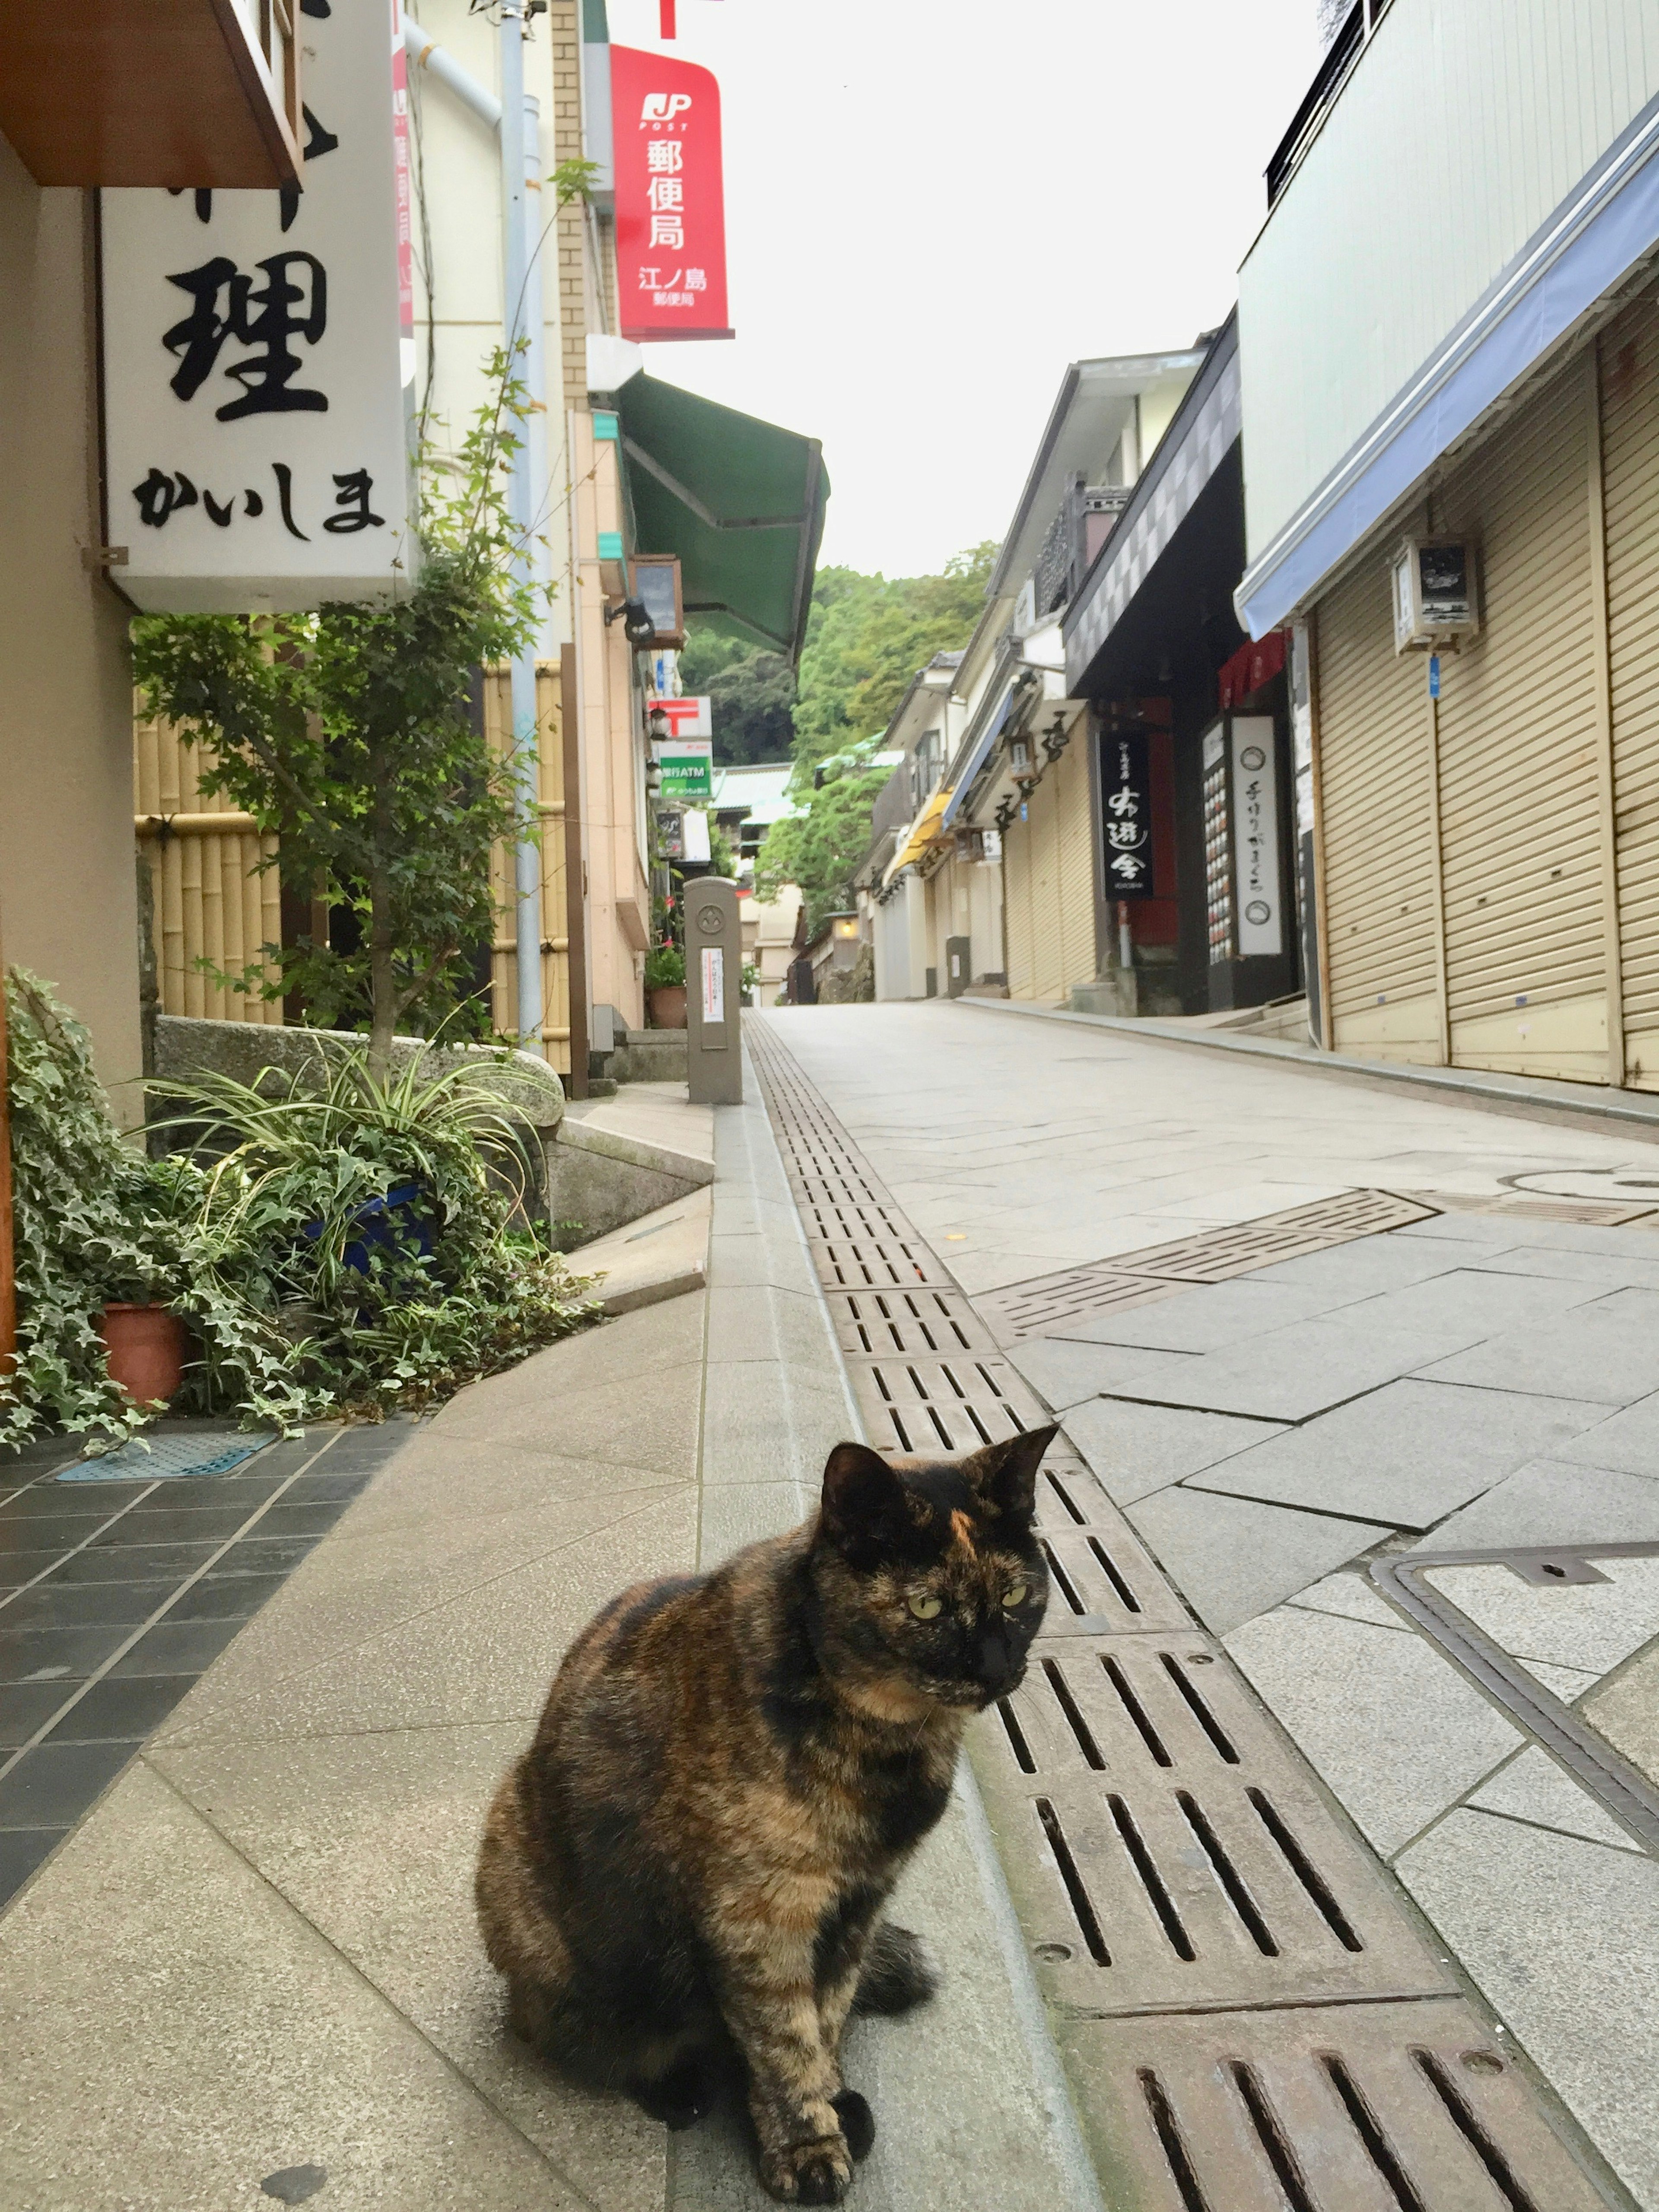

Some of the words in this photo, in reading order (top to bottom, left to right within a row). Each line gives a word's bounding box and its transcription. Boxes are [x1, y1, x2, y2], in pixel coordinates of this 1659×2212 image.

[642, 93, 692, 121] JP
[639, 121, 687, 131] POST
[647, 140, 684, 250] 郵便局
[639, 267, 707, 292] 江ノ島
[653, 291, 694, 306] 郵便局
[133, 462, 386, 541] かいしま
